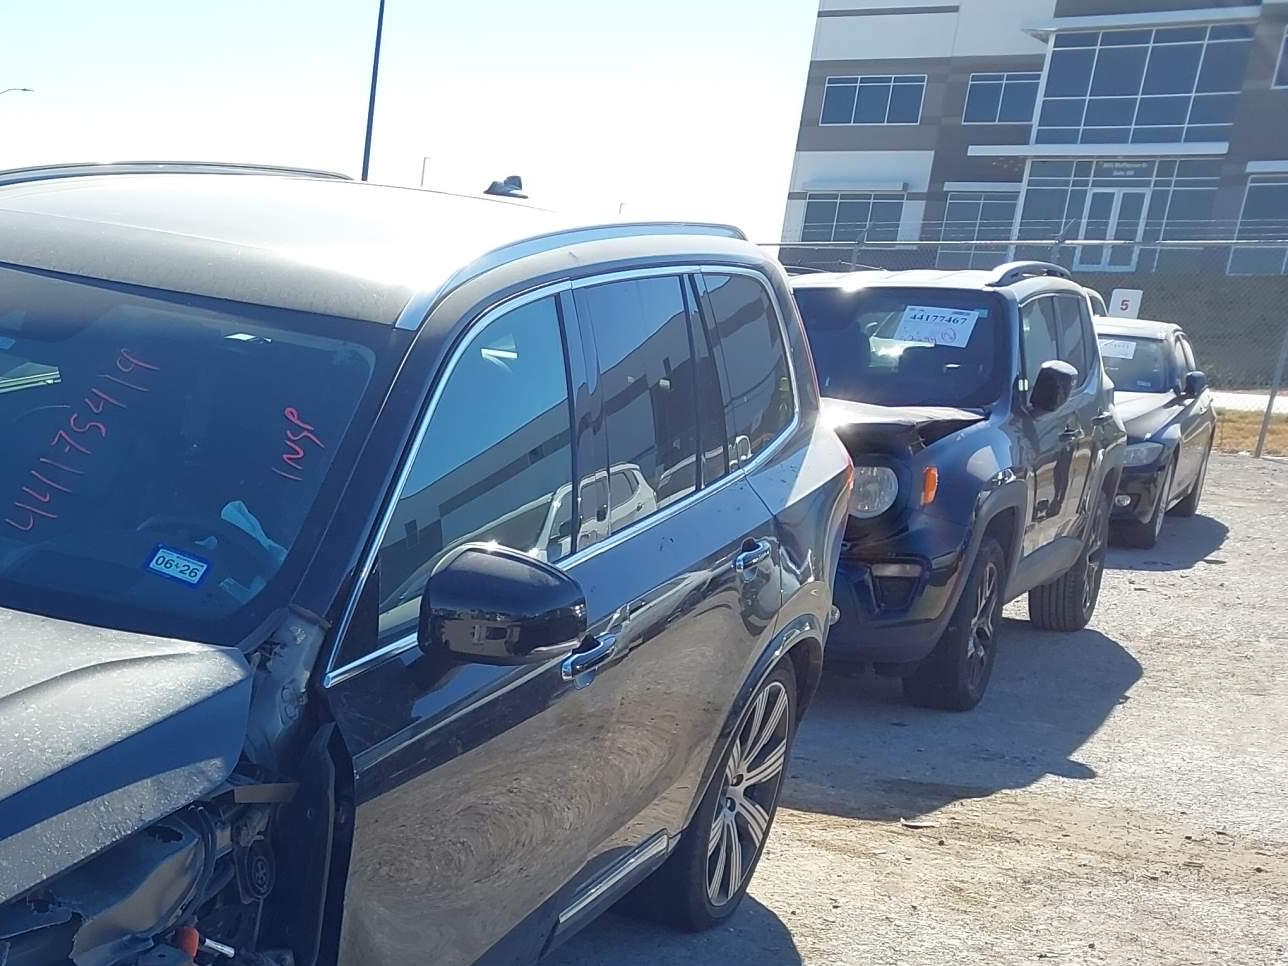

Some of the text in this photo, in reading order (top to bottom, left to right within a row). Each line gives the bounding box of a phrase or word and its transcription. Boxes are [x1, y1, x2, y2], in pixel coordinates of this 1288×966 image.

[1120, 299, 1130, 311] 5
[5, 348, 160, 531] 44175419
[272, 407, 325, 481] INSP
